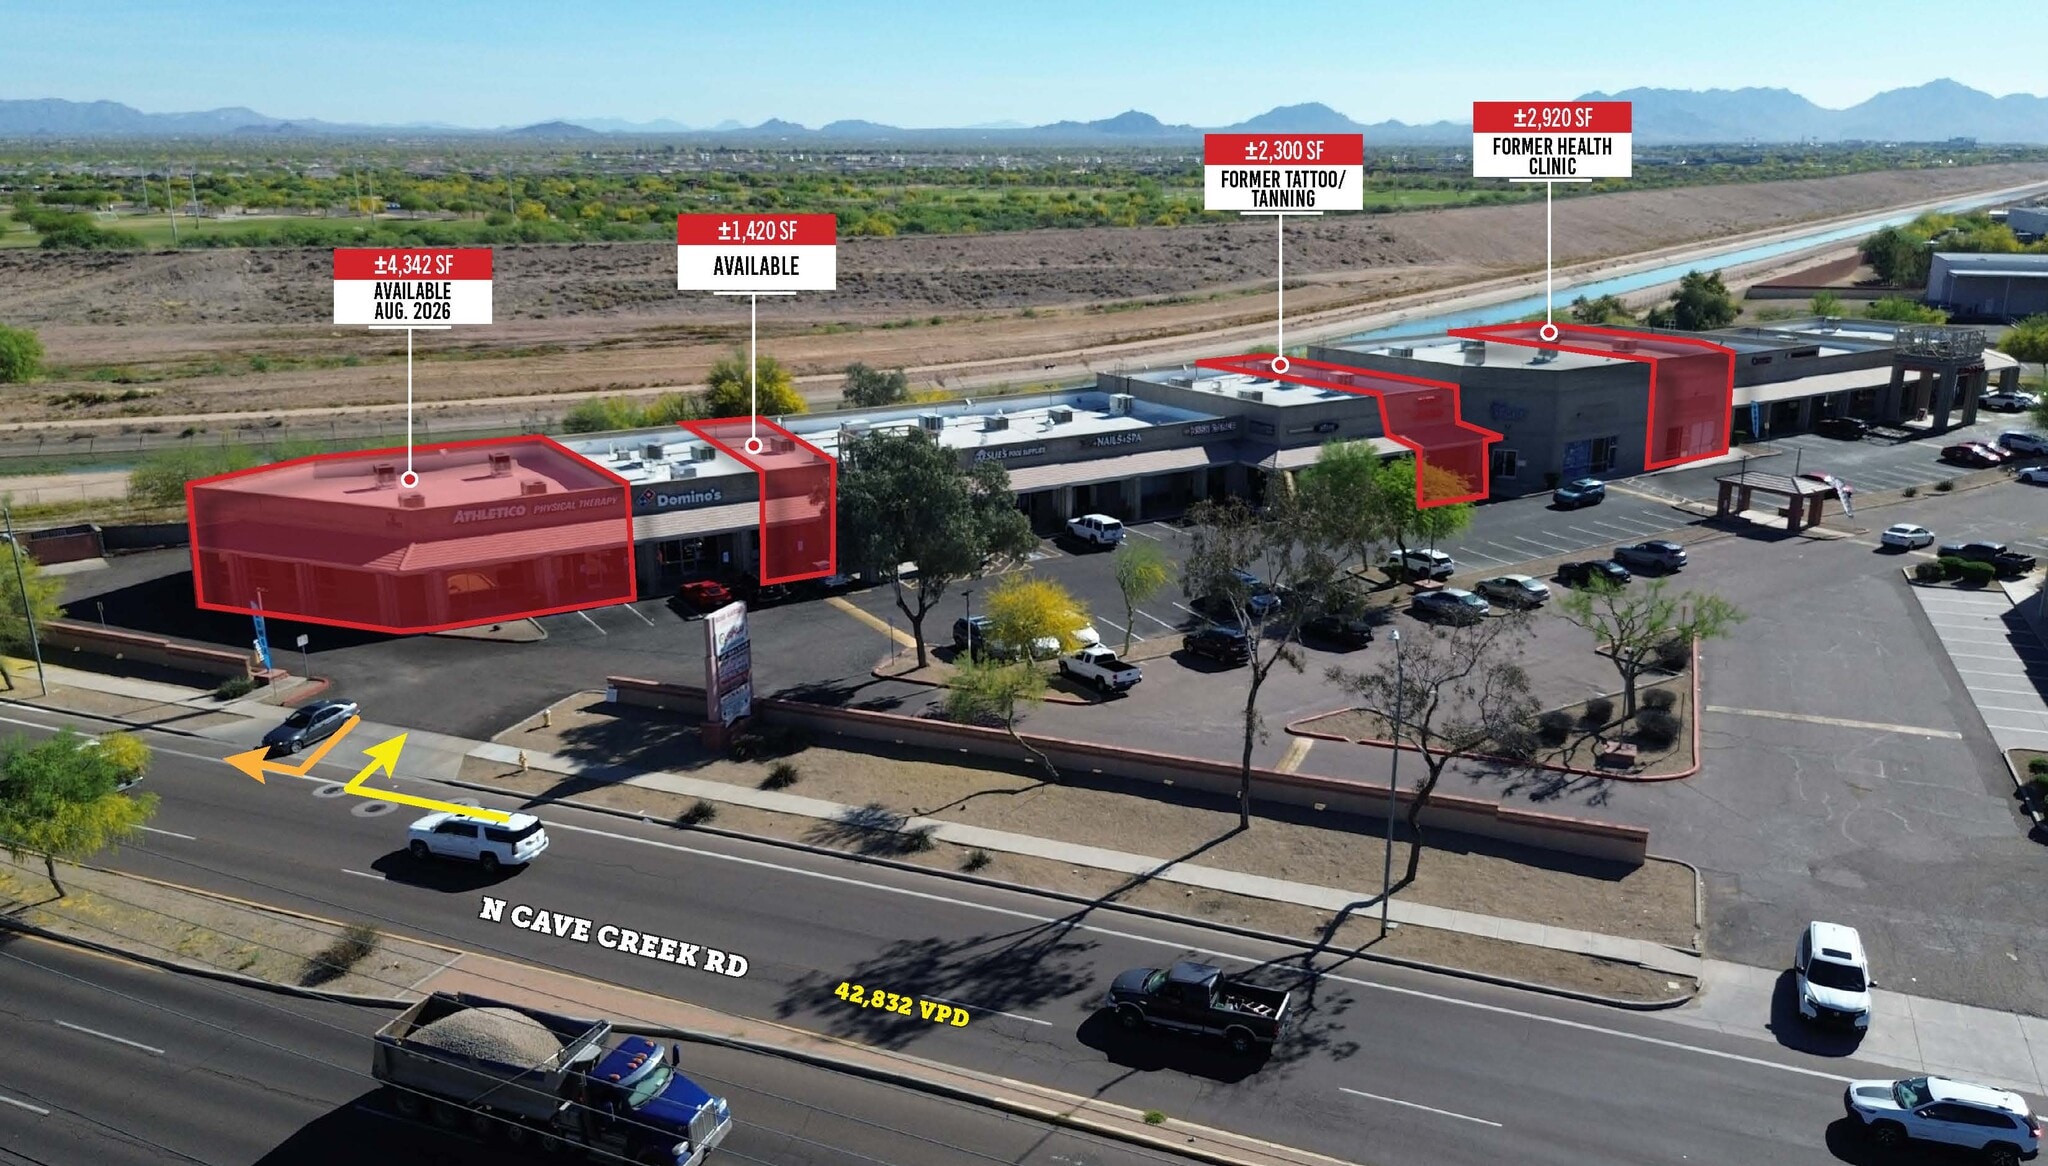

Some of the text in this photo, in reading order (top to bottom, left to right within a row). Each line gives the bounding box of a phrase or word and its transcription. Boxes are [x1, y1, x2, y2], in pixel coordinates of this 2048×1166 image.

[657, 489, 722, 507] Domino's
[454, 496, 618, 523] ATHLETICO PHYSICAL THERAPY
